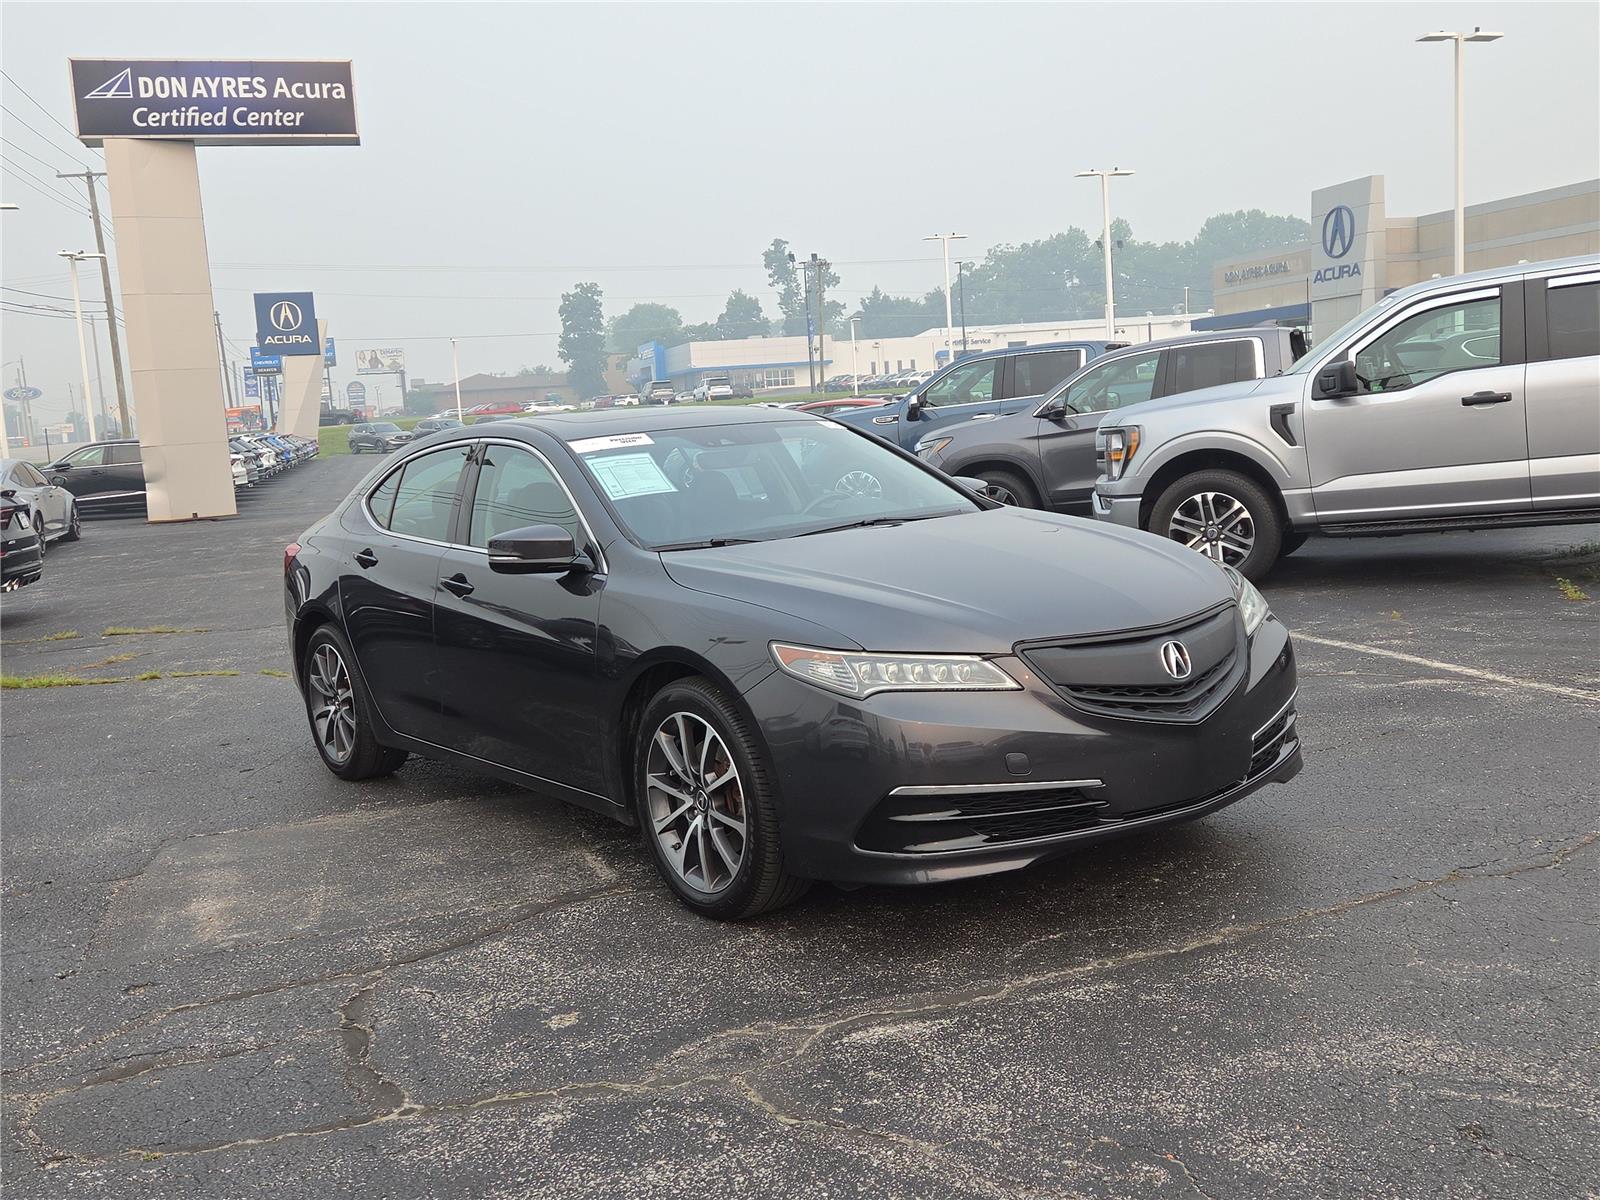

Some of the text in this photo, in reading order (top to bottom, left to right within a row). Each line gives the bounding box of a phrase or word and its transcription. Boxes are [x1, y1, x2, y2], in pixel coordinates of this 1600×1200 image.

[138, 76, 346, 99] DON AYRES Acura
[132, 106, 304, 127] Certified Center
[1313, 263, 1361, 284] ACURA
[264, 335, 312, 344] ACURA
